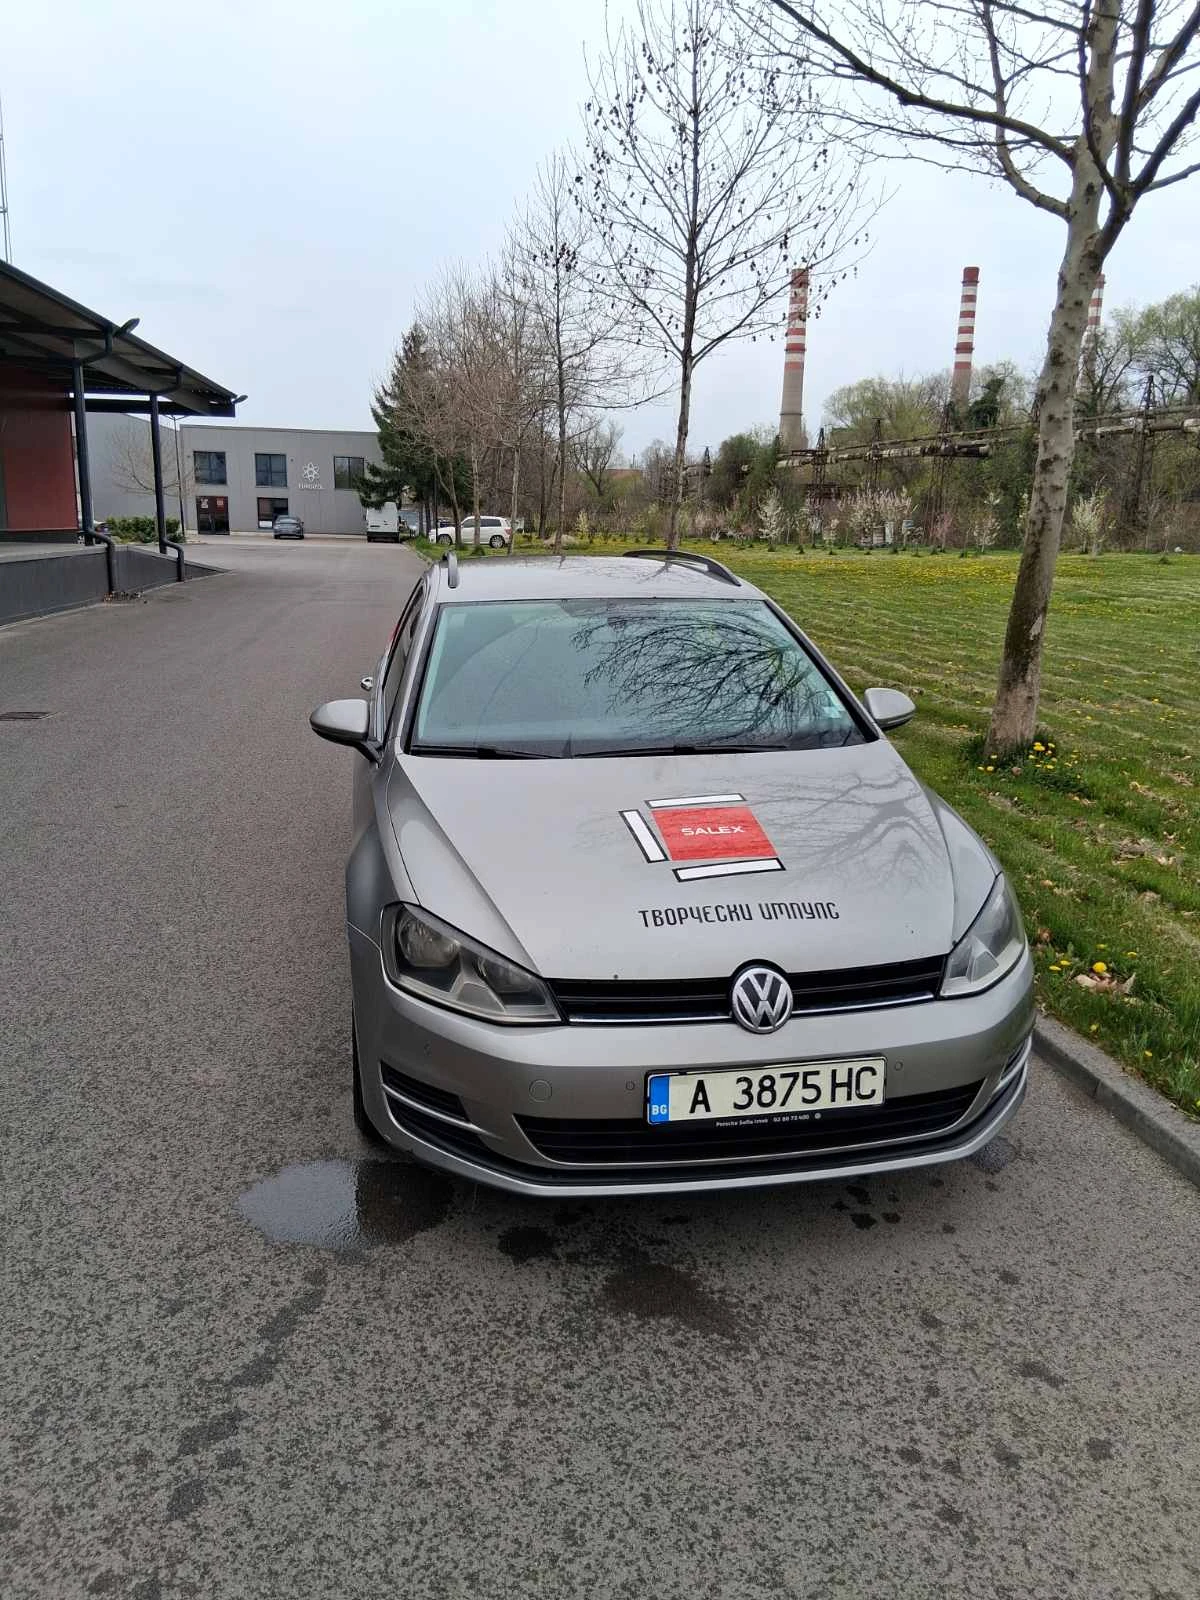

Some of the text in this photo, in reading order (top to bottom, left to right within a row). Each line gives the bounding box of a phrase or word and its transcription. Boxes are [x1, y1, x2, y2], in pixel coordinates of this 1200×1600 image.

[681, 825, 746, 836] SALEX
[638, 901, 840, 928] ТВОРЧЕСКИ ИМПУЛС
[689, 1079, 711, 1114] A
[733, 1070, 822, 1110] 3875
[651, 1104, 668, 1116] BG
